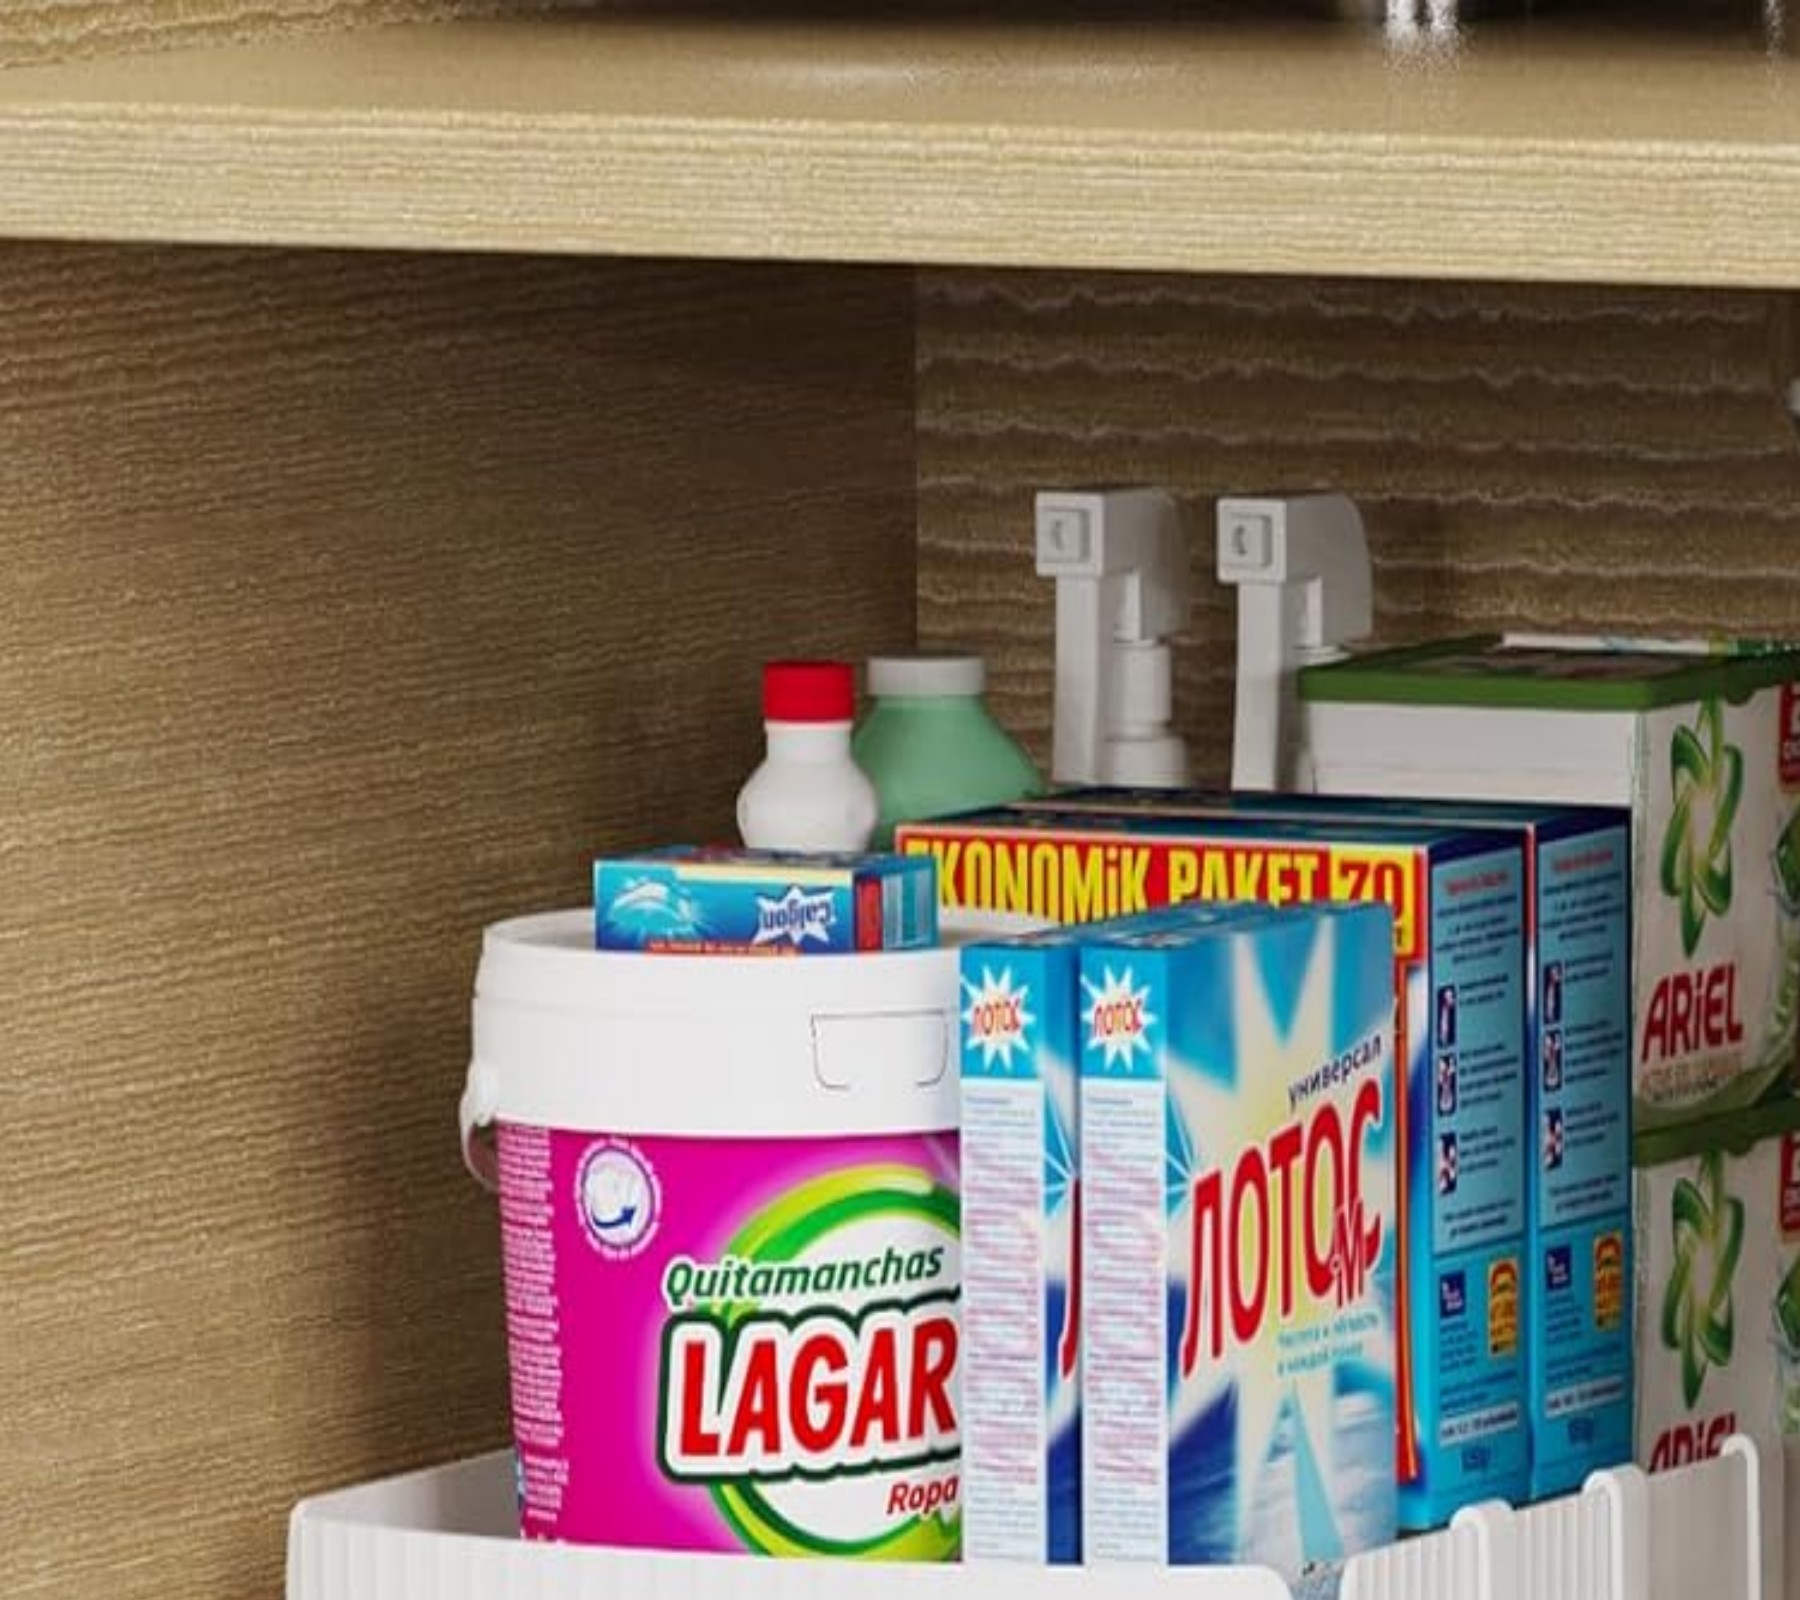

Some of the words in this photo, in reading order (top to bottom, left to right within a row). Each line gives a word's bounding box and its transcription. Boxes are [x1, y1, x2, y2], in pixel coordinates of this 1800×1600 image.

[1169, 848, 1320, 904] PAKET
[1340, 861, 1404, 918] 70
[665, 1243, 943, 1304] Quitamanchas
[680, 1320, 959, 1456] LAGAR
[888, 1476, 959, 1514] Ropa
